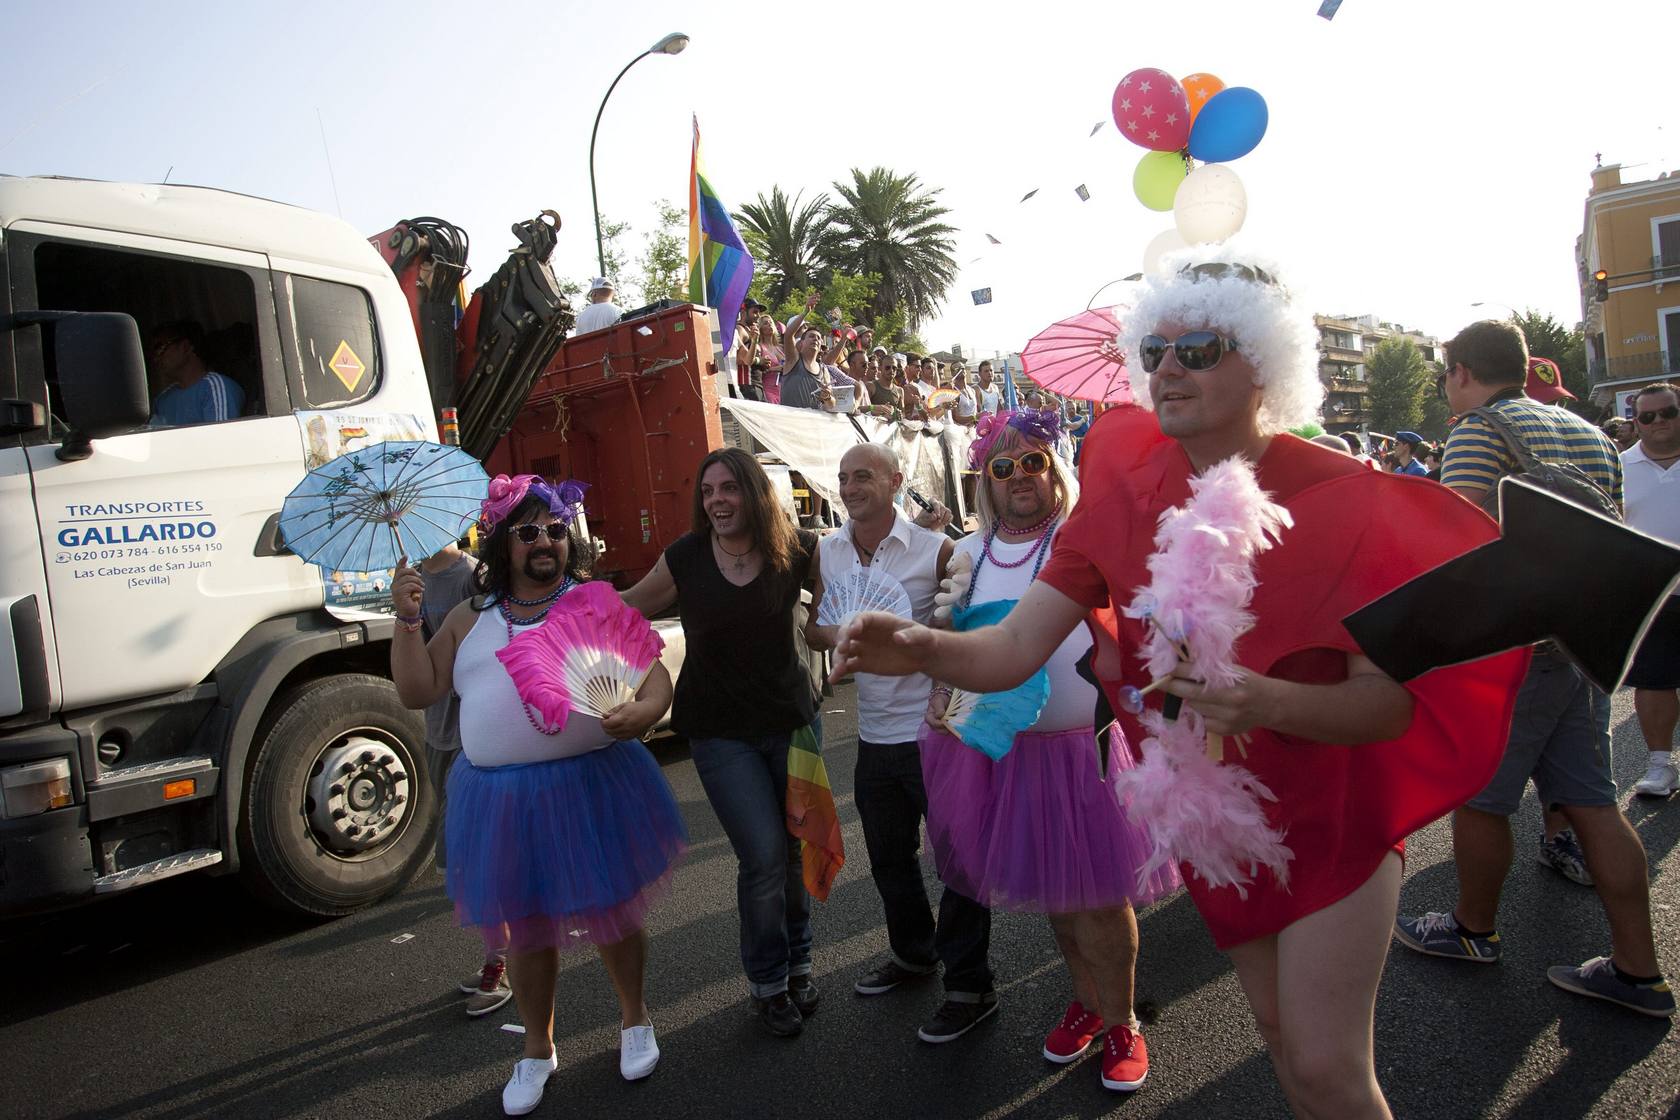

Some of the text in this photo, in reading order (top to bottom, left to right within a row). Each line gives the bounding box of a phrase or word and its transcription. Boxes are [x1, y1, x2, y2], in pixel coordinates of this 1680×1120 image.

[65, 500, 204, 517] TRANSPORTES
[57, 521, 217, 548] GALLARDO
[73, 551, 98, 561] 620
[100, 549, 124, 559] 073
[127, 547, 149, 557] 784
[157, 545, 179, 555] 616
[181, 543, 201, 554] 554
[205, 542, 223, 552] 150
[74, 560, 212, 579] Las Cabezas de San Juan
[127, 575, 171, 590] (Sevilla)
